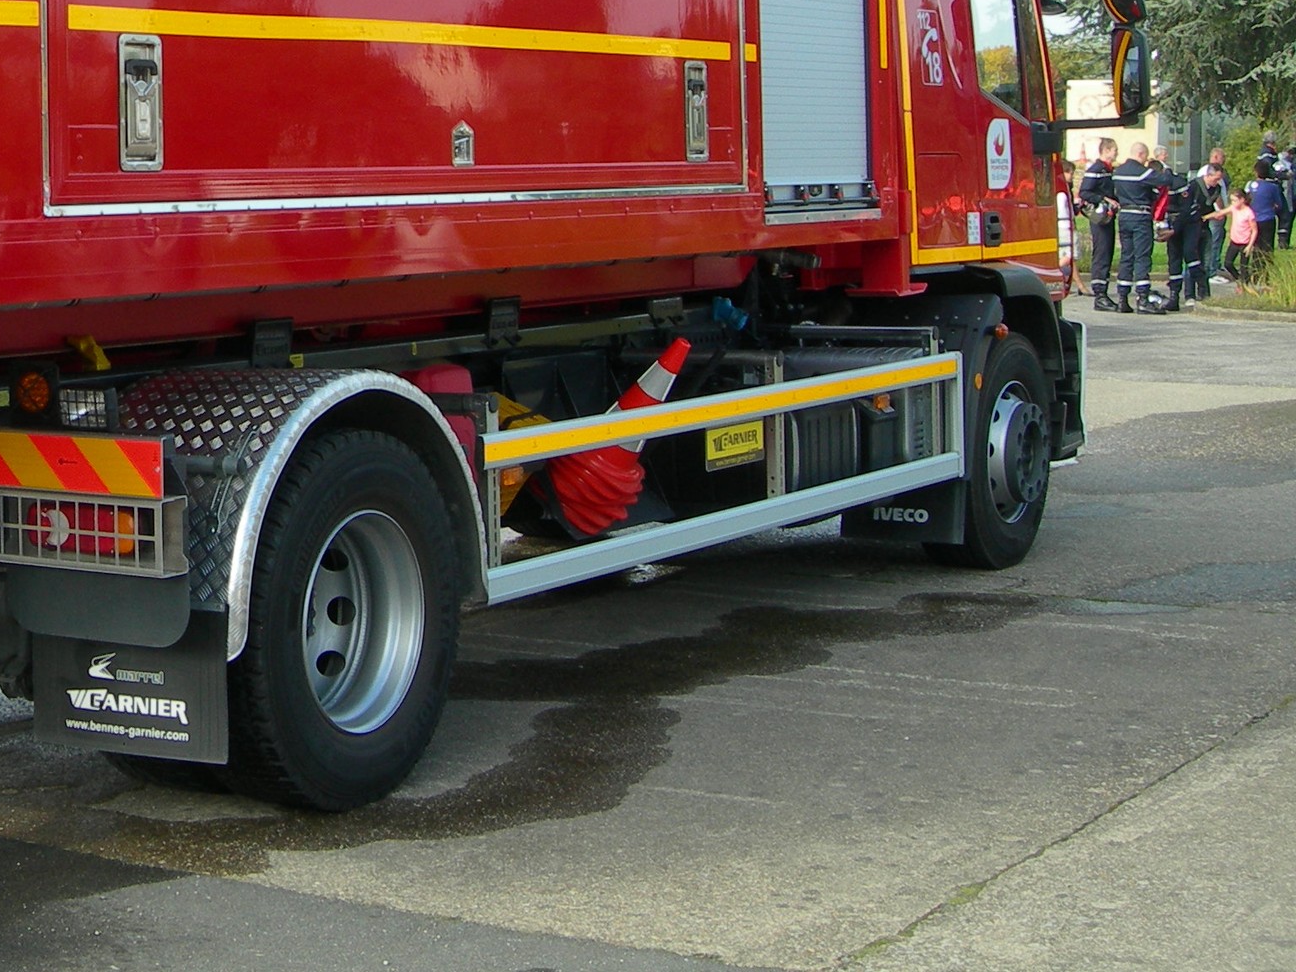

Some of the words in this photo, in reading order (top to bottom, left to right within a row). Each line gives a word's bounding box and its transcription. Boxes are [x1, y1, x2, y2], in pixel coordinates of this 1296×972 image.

[917, 12, 931, 29] 112
[926, 50, 942, 83] 18
[873, 507, 929, 523] IVECO
[116, 669, 164, 685] marrel
[67, 688, 189, 725] GARNIER
[65, 718, 190, 741] www.bennes-garnier.com
